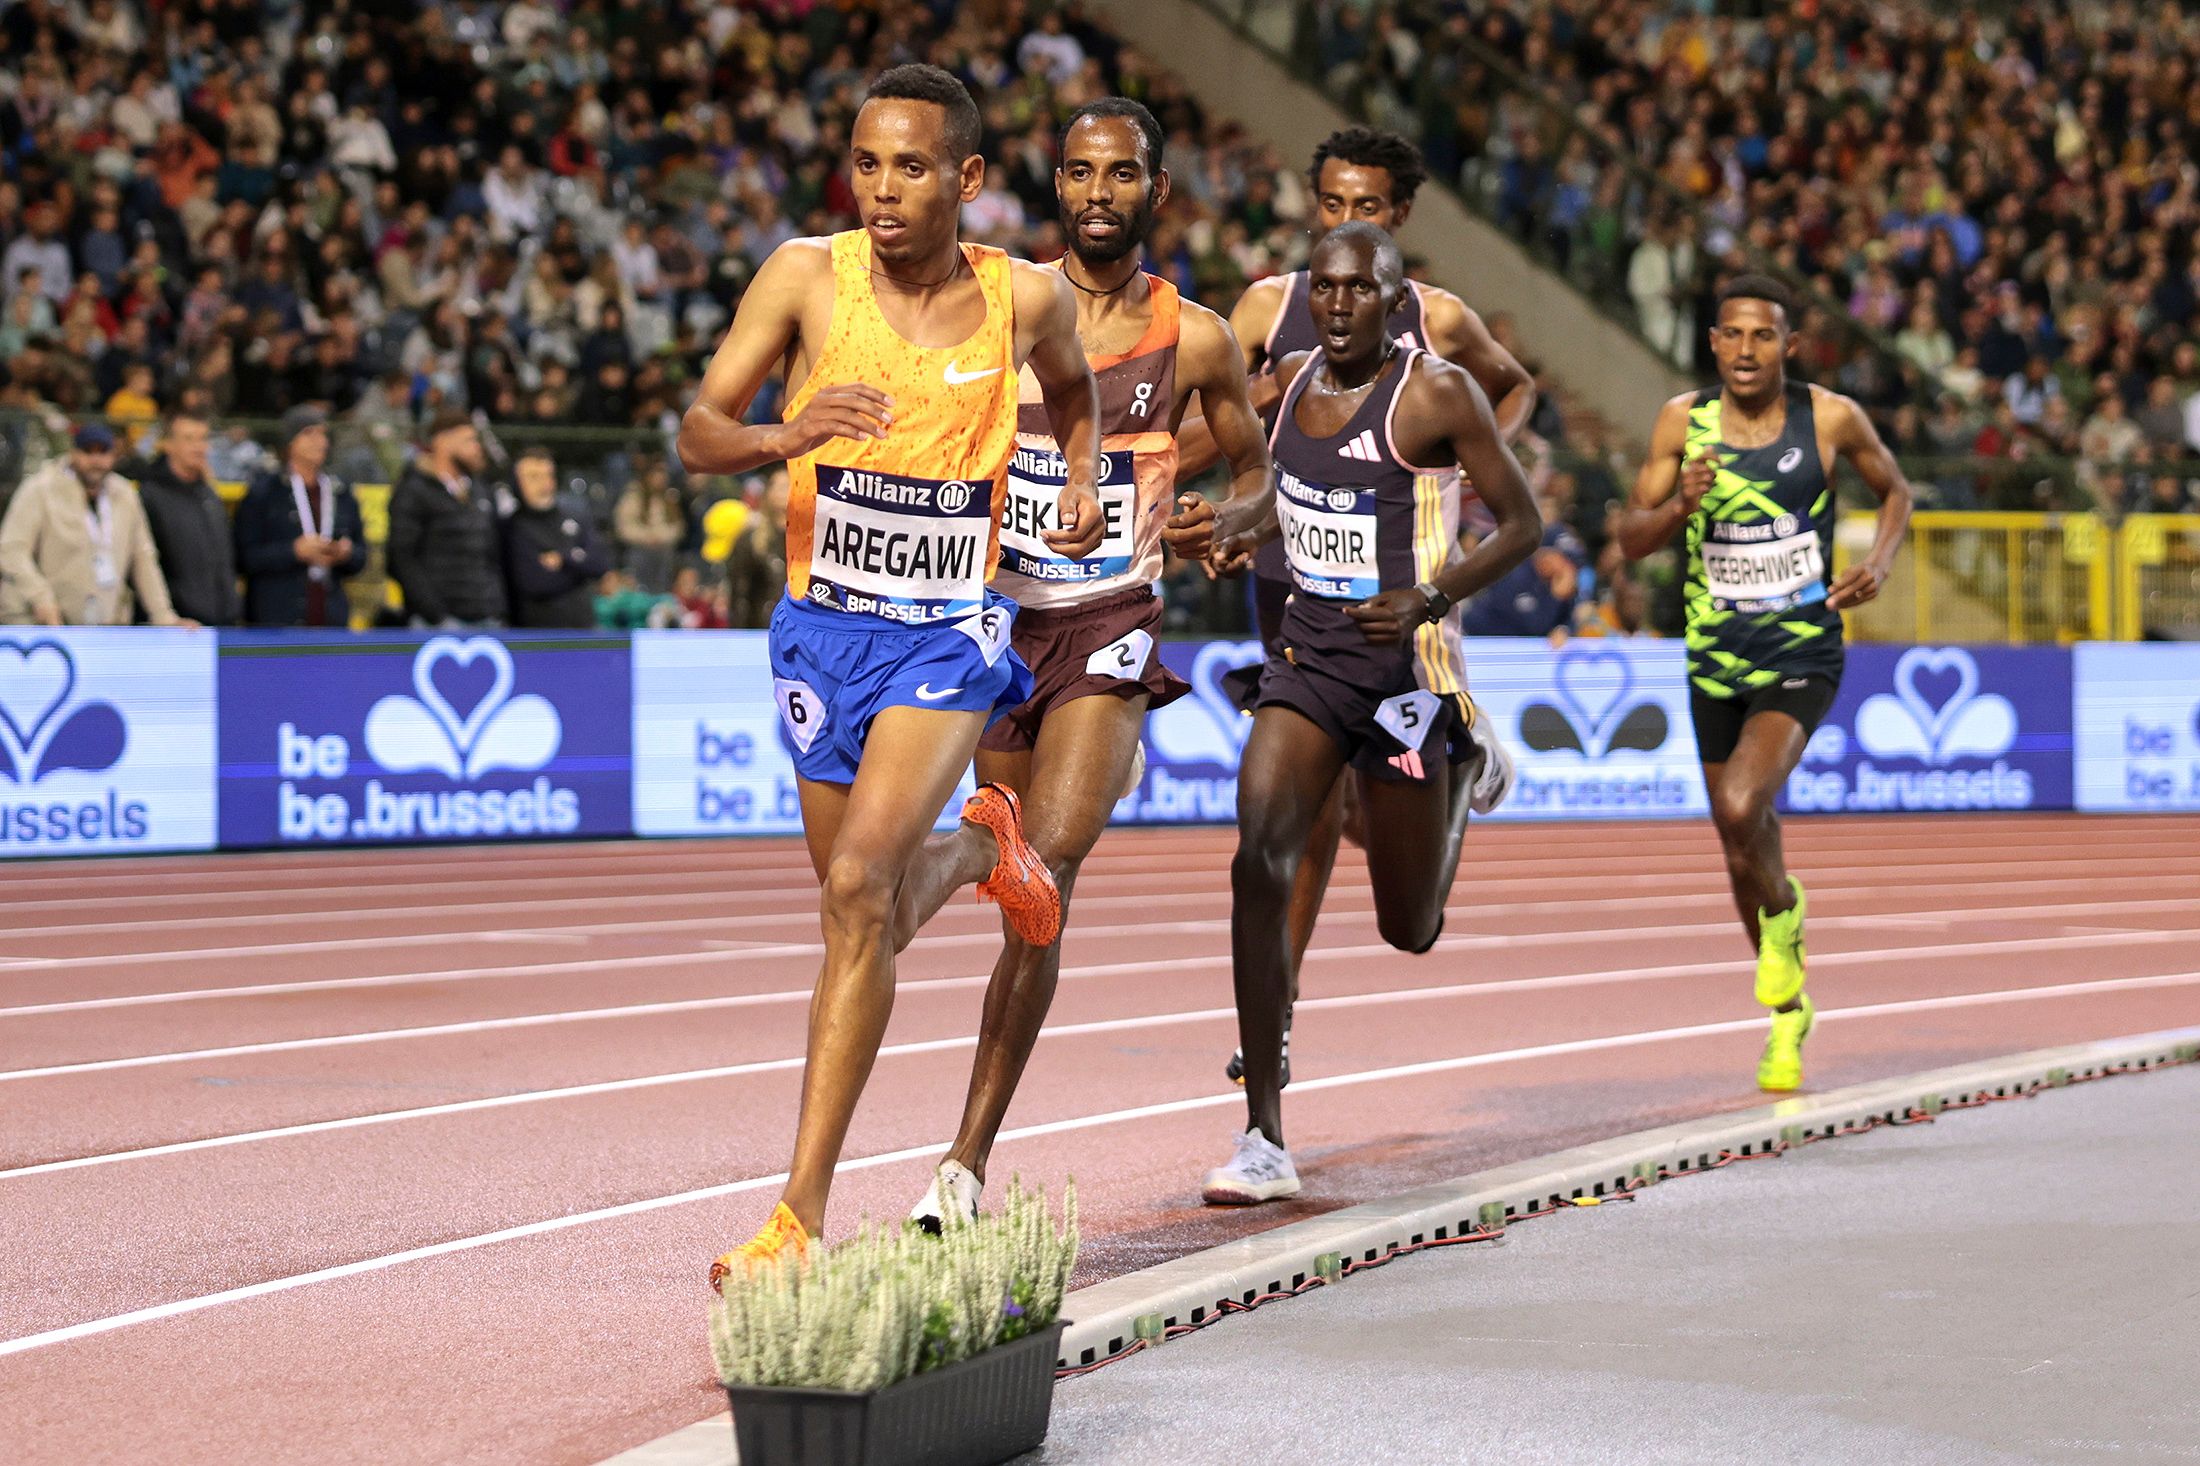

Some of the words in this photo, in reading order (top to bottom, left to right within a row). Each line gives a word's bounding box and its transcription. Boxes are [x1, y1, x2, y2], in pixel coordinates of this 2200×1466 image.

[1008, 451, 1068, 478] Allian
[838, 470, 932, 506] Allianz
[1280, 470, 1325, 506] Allianz
[1001, 494, 1122, 539] BEKE
[1713, 521, 1773, 541] Allianz
[820, 517, 977, 579] AREGAWI
[1709, 544, 1811, 584] GEBRHIWET
[1018, 557, 1101, 579] BRUSSELS
[1292, 569, 1351, 595] USSELS
[846, 594, 945, 621] BRUSSELS
[981, 613, 999, 643] 6
[1111, 643, 1135, 667] 2
[789, 691, 807, 724] 6
[1400, 701, 1419, 729] 5
[278, 722, 349, 779] be
[696, 719, 753, 767] be
[1801, 724, 1847, 765] e
[2124, 716, 2175, 756] be
